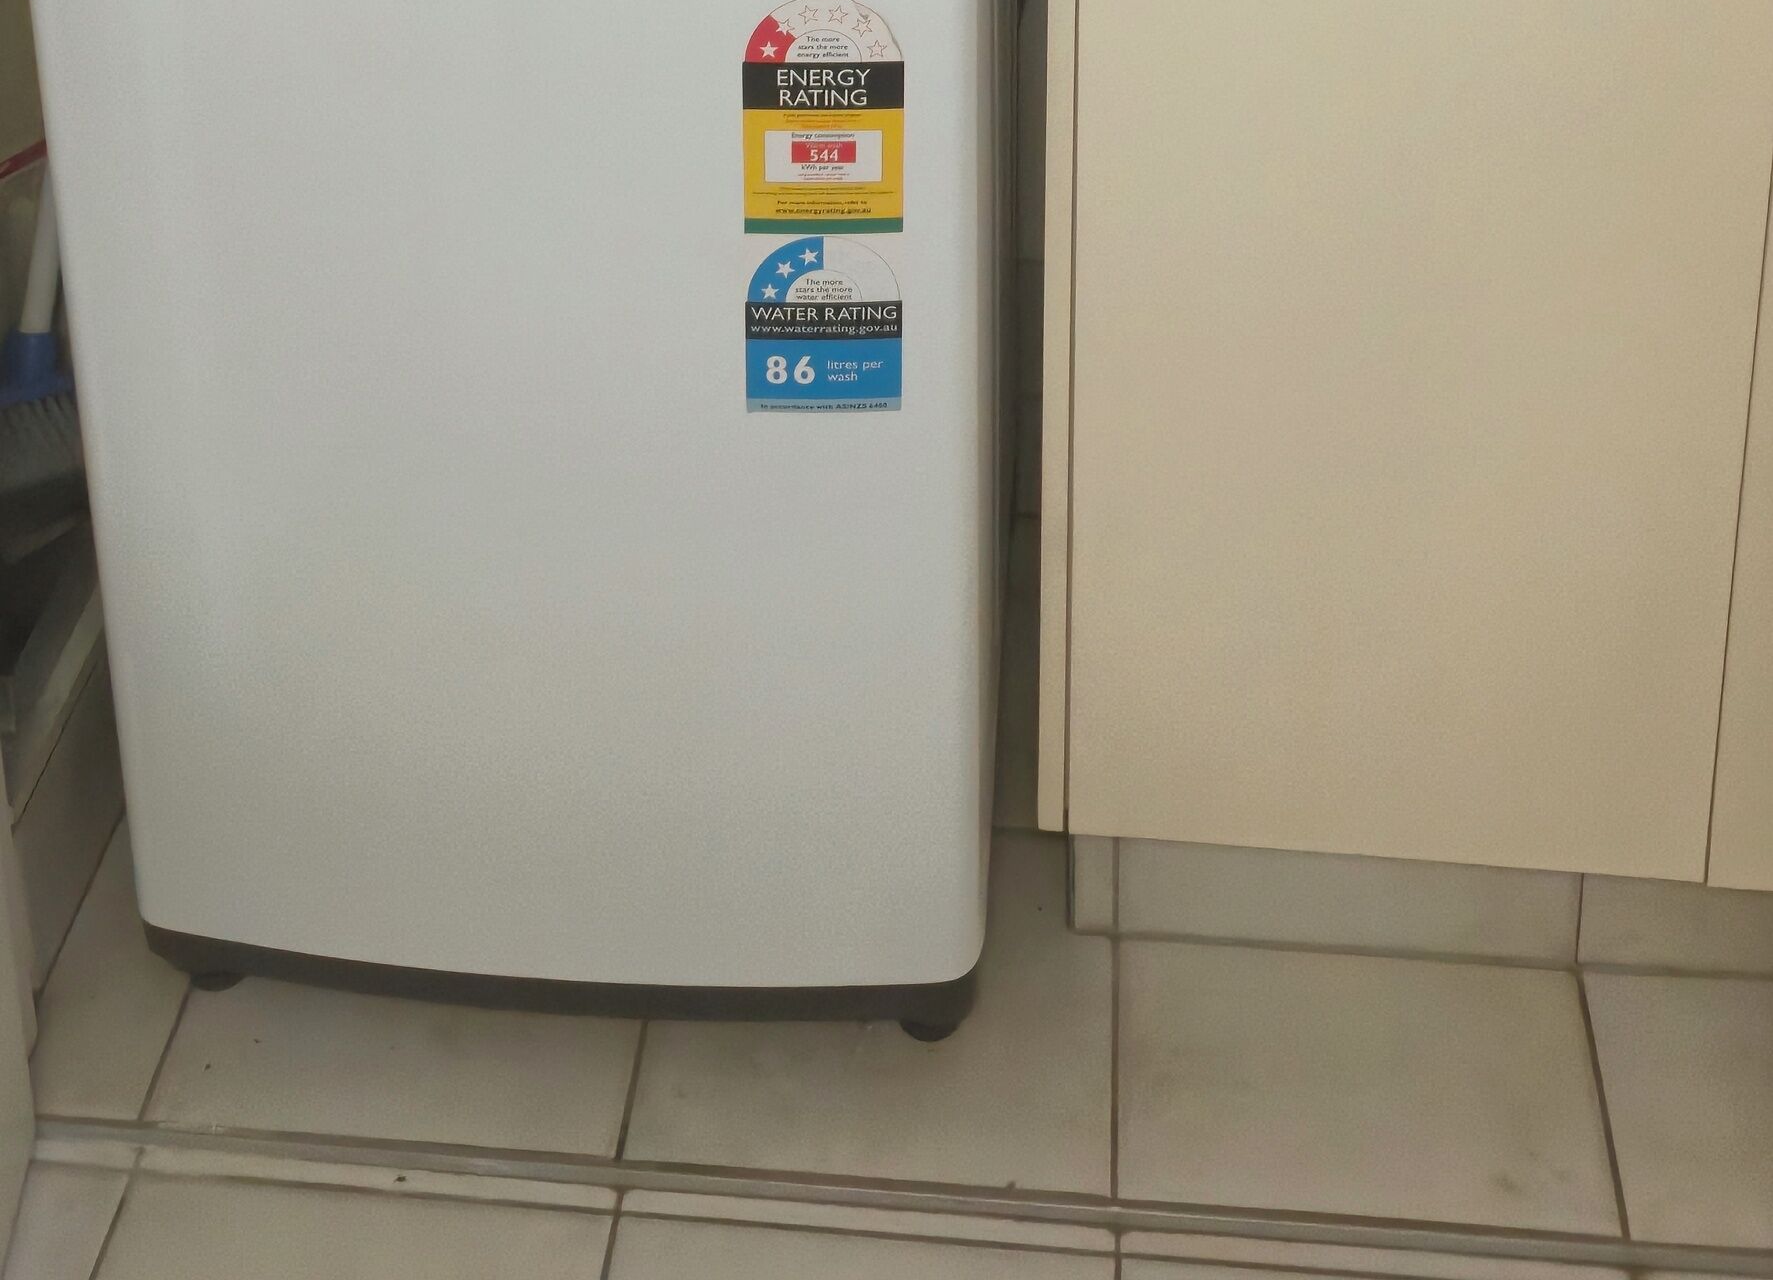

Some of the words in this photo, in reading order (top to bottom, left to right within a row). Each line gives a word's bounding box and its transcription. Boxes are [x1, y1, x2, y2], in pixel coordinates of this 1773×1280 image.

[806, 35, 821, 43] The
[776, 67, 871, 88] ENERGY
[779, 89, 868, 107] RATING
[791, 132, 813, 140] Energy
[810, 148, 839, 162] 544
[806, 278, 821, 286] The
[821, 293, 853, 301] efficient
[751, 307, 819, 321] WATER
[824, 305, 898, 321] RATING
[750, 323, 898, 336] www.waterrating.gov.au
[766, 355, 816, 385] 86
[827, 359, 858, 370] litres
[862, 361, 885, 372] per
[827, 371, 858, 382] wash
